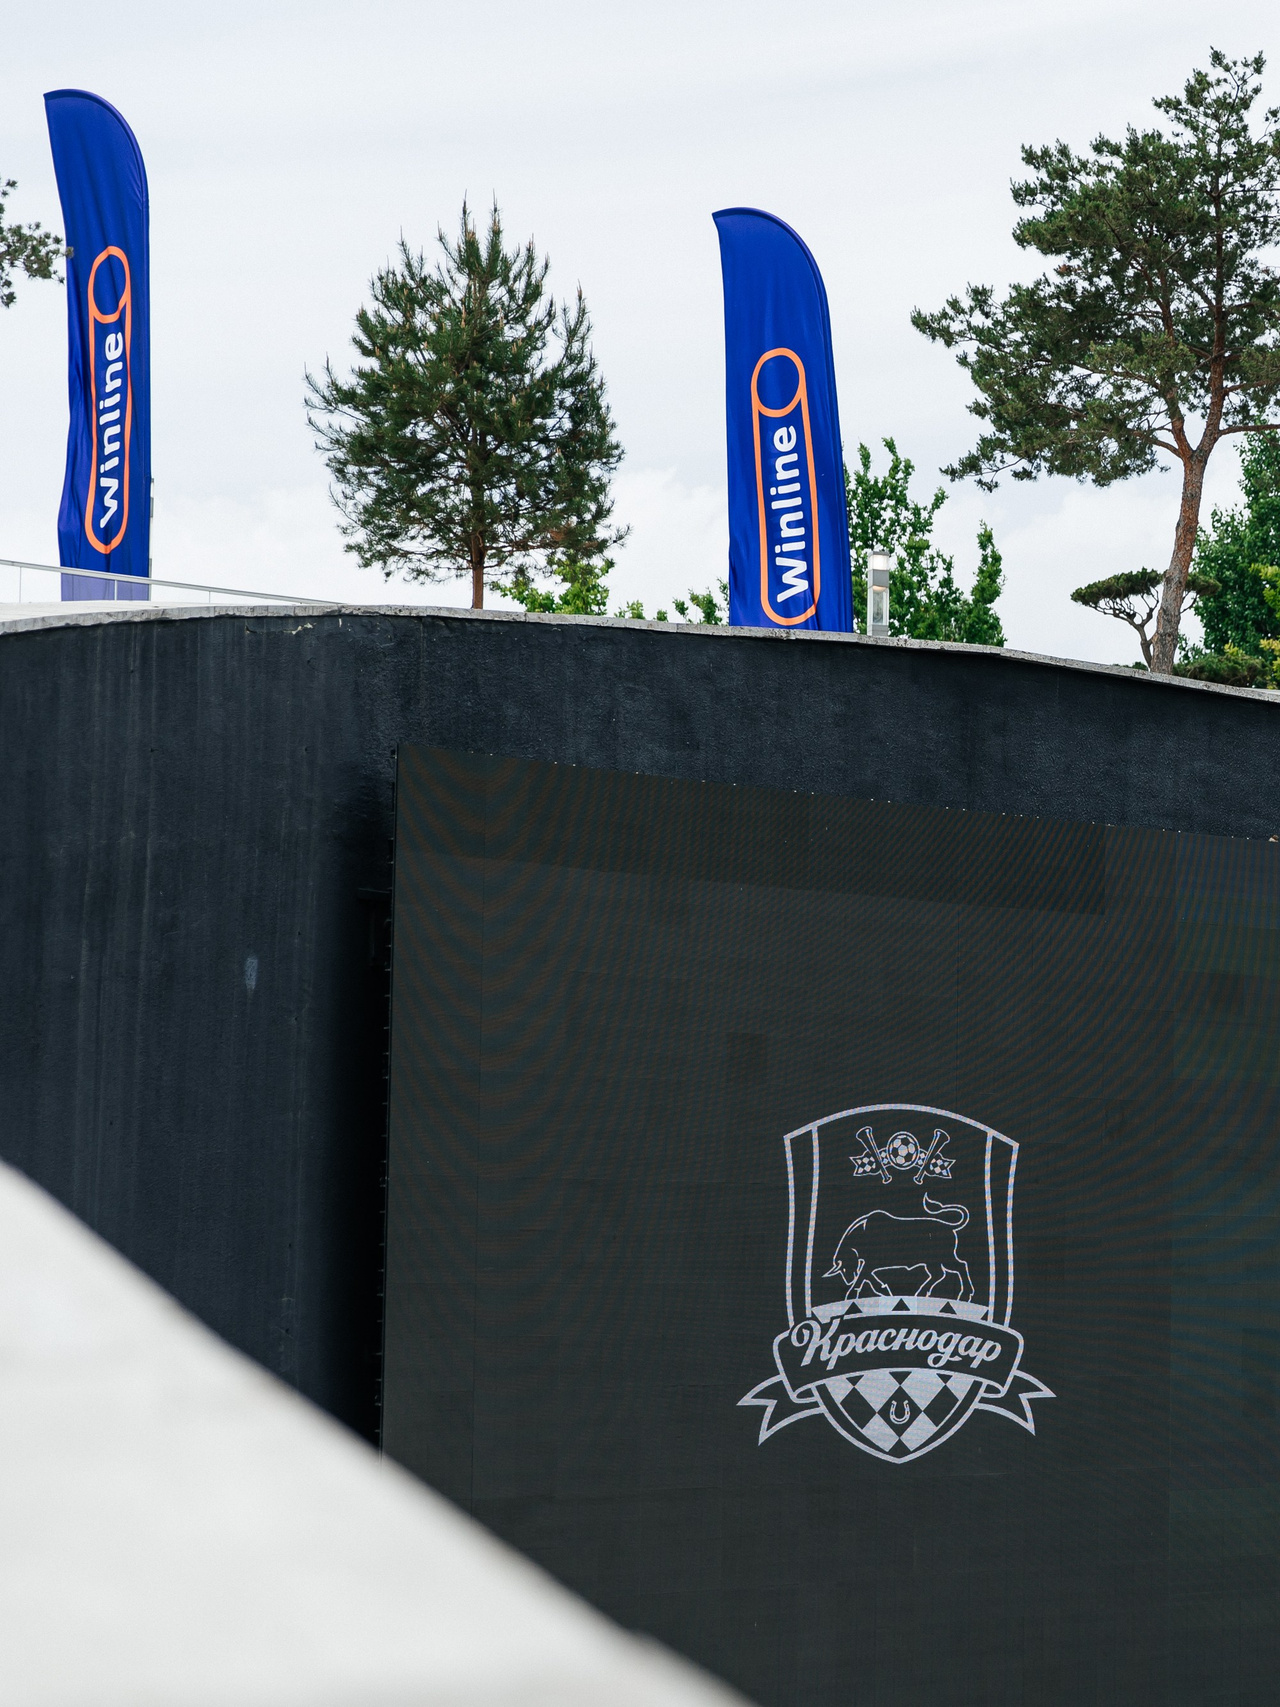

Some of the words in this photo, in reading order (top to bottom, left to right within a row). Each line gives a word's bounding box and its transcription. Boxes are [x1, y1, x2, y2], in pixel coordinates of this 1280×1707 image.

[99, 331, 124, 529] Winline
[769, 425, 809, 604] Winline
[790, 1317, 1001, 1370] Краснодар
